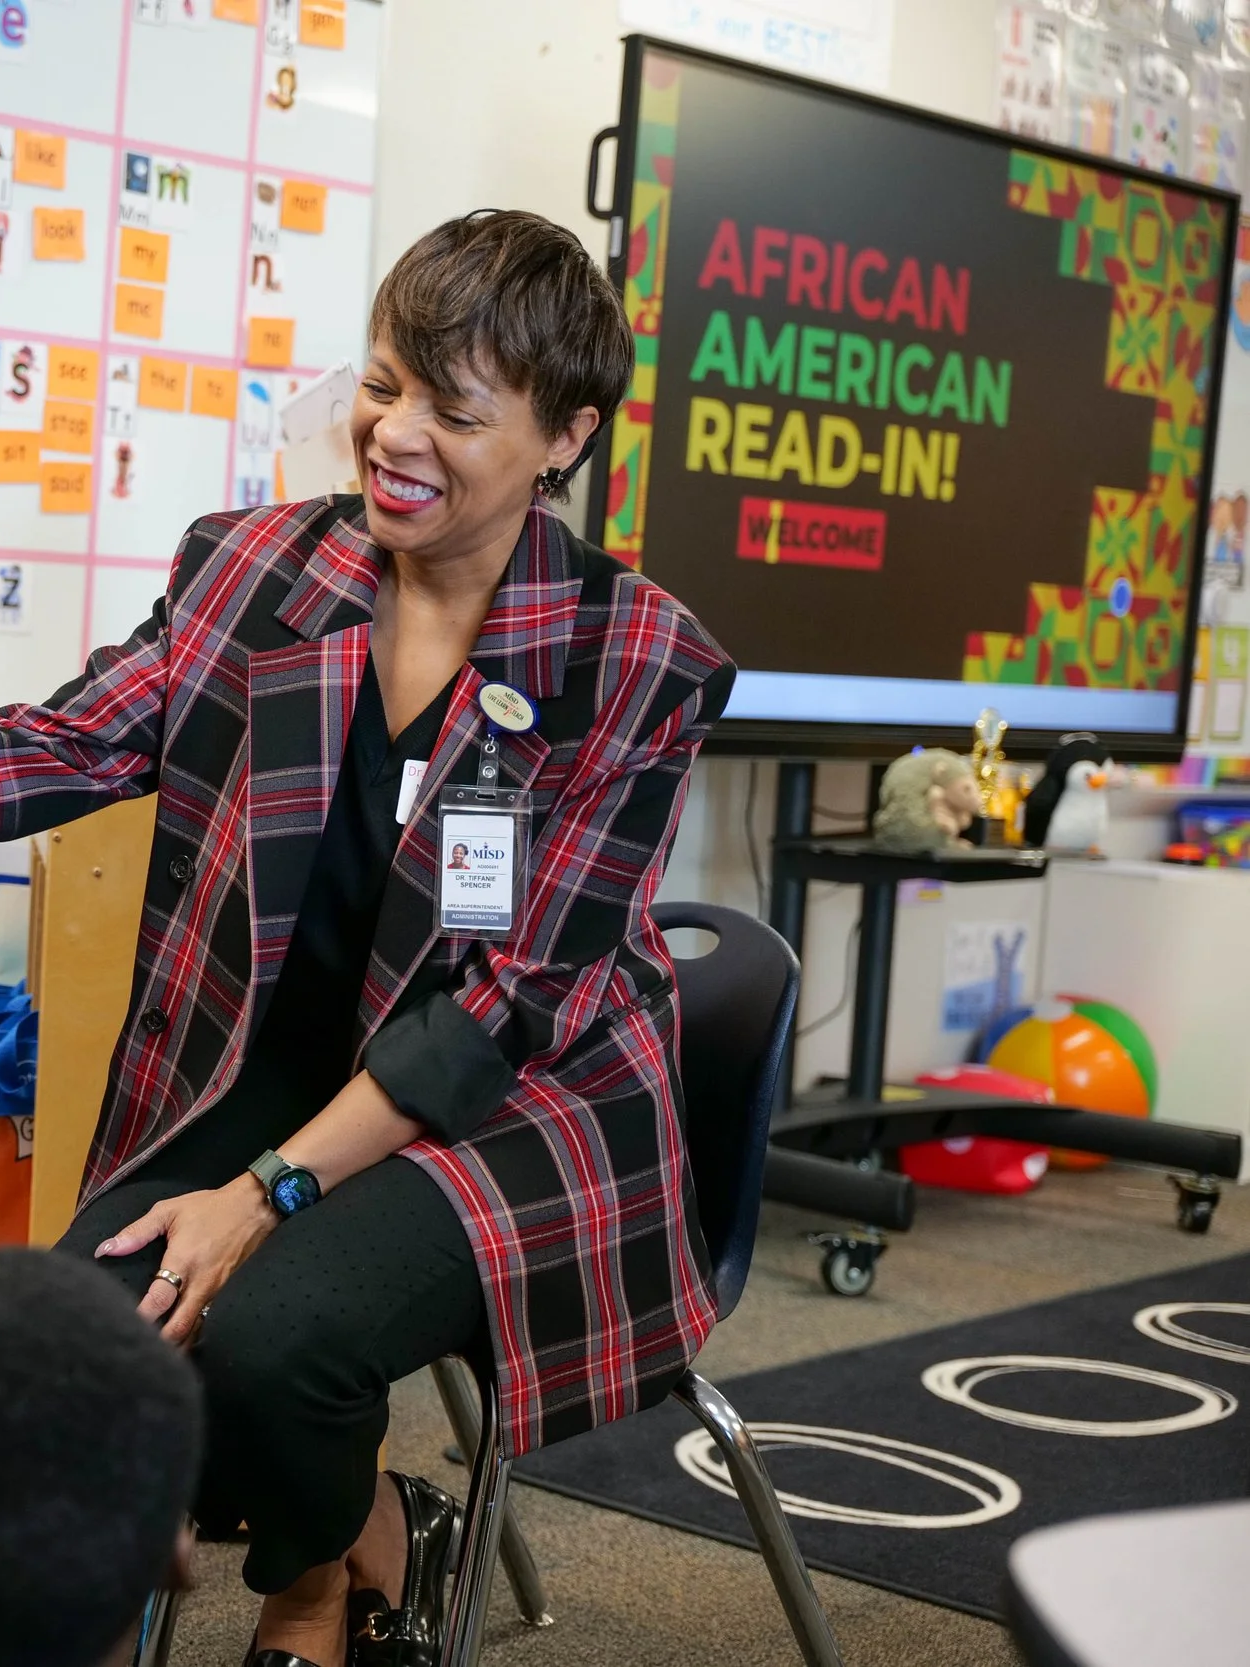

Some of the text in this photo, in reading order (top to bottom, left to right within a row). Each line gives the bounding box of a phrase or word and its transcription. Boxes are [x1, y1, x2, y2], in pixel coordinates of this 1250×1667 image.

[41, 217, 77, 240] look
[698, 217, 971, 336] AFRICAN
[58, 362, 88, 382] see
[689, 310, 1013, 428] AMERICAN
[3, 444, 26, 463] sit
[685, 395, 961, 503] READ-IN!
[50, 472, 86, 494] said
[750, 515, 880, 556] WELCOME
[472, 847, 505, 860] MISD
[460, 881, 492, 889] SPENCER
[451, 913, 499, 921] ADMINISTRATION
